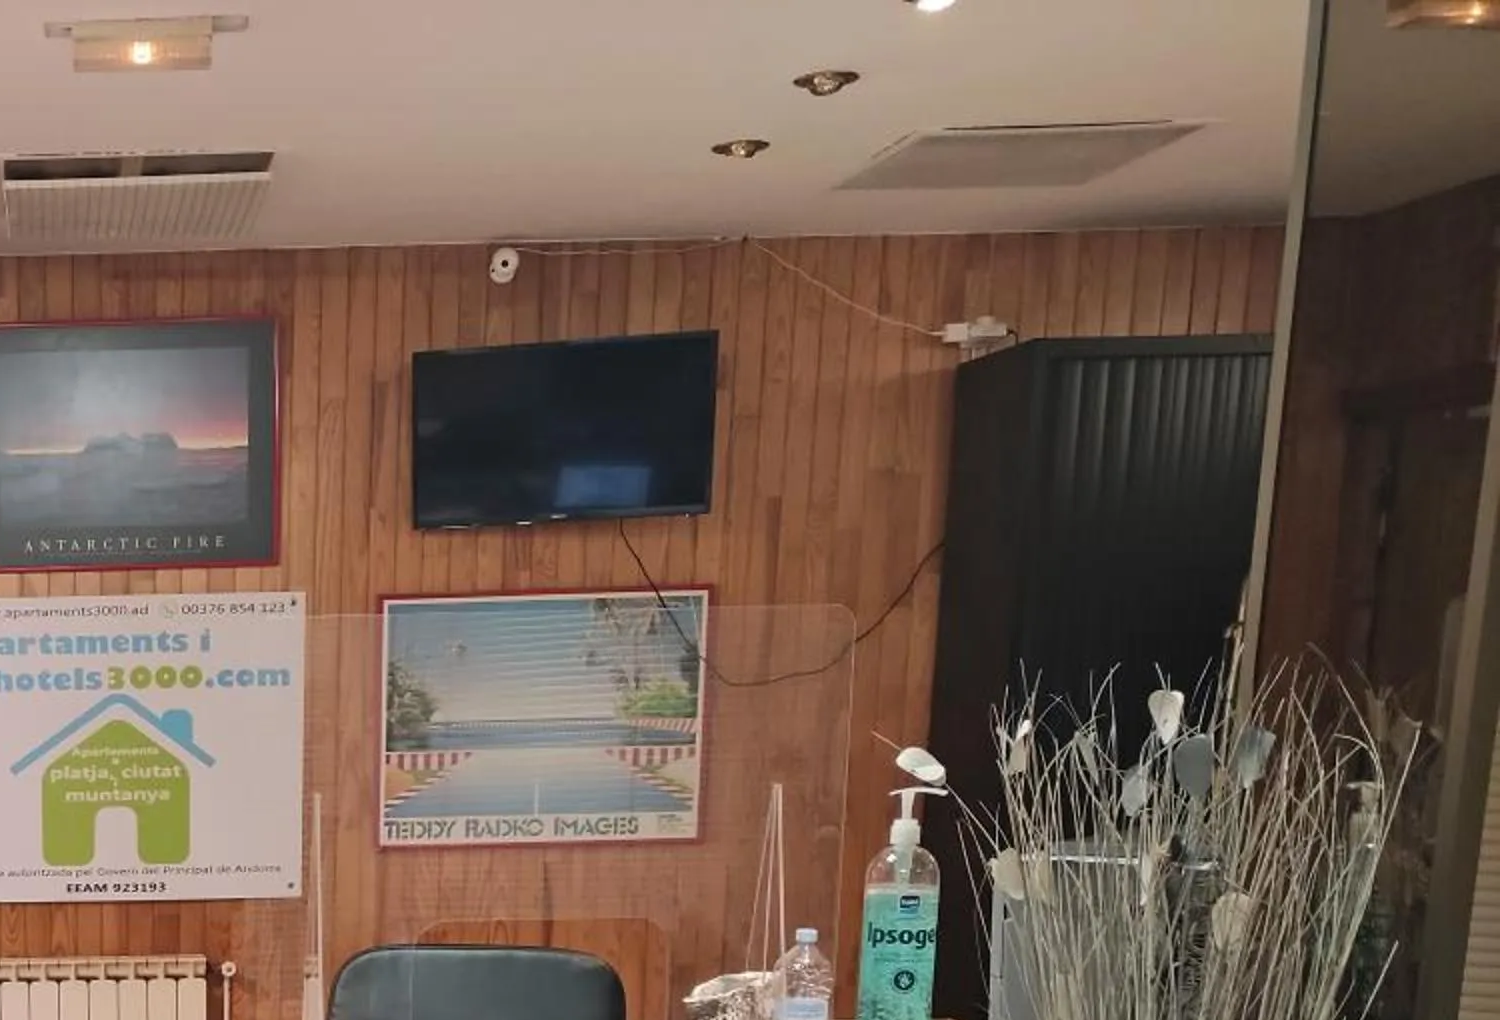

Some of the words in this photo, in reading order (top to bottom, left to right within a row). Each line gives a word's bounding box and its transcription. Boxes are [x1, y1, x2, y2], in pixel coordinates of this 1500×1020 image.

[23, 537, 158, 554] ANTARCTIC
[172, 535, 226, 549] FIRE
[181, 603, 226, 616] 00376
[229, 603, 256, 615] 854
[260, 602, 286, 615] 123
[199, 628, 212, 652] i
[121, 763, 182, 779] ciutat
[64, 789, 171, 805] muntanya
[384, 820, 456, 841] TEDDY
[553, 816, 640, 837] IMAGES
[7, 867, 74, 879] autoritzada
[98, 866, 139, 877] Govern
[162, 864, 213, 878] Principal
[235, 864, 282, 875] Andorra
[66, 883, 109, 893] EEAM
[112, 881, 167, 893] 923193
[868, 921, 935, 950] Ipsoge
